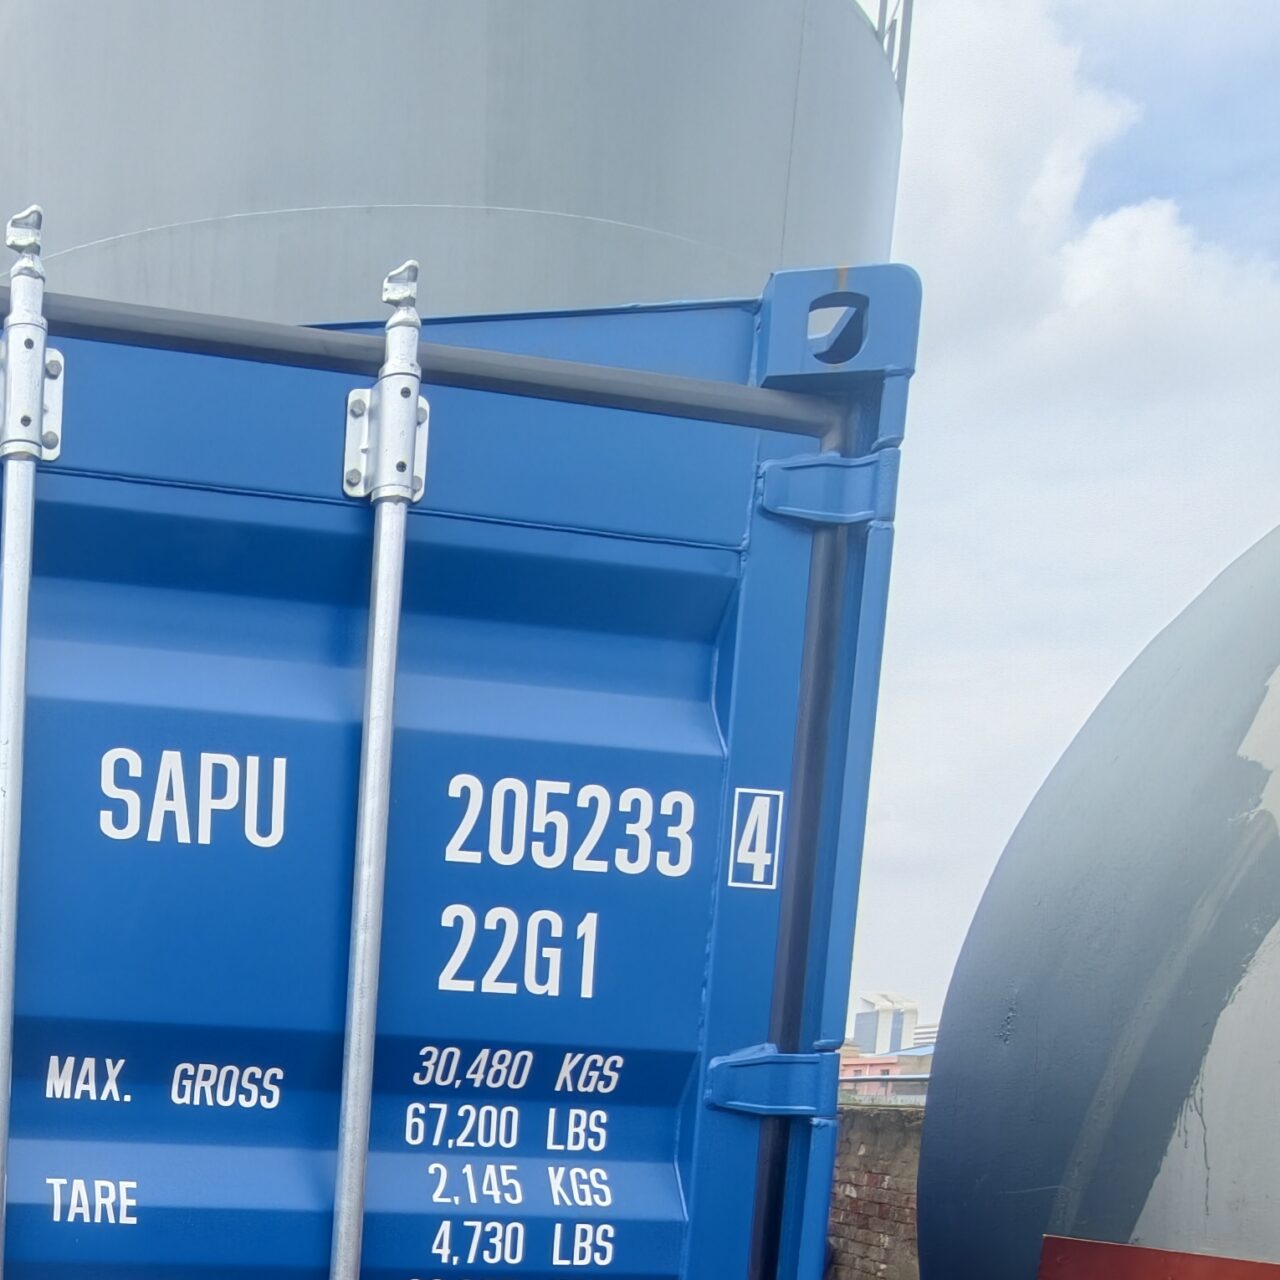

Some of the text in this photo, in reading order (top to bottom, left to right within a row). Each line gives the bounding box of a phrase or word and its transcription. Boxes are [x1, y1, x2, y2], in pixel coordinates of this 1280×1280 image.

[99, 747, 772, 882] SAPU 205233 4
[438, 903, 598, 999] 22G1
[45, 1055, 284, 1109] MAX. GROSS
[414, 1046, 624, 1094] 30,480 KGS
[405, 1102, 608, 1152] 67,200 LBS
[45, 1177, 138, 1225] TARE
[429, 1163, 613, 1208] 2,145 KGS
[431, 1220, 615, 1266] 4,730 LBS
